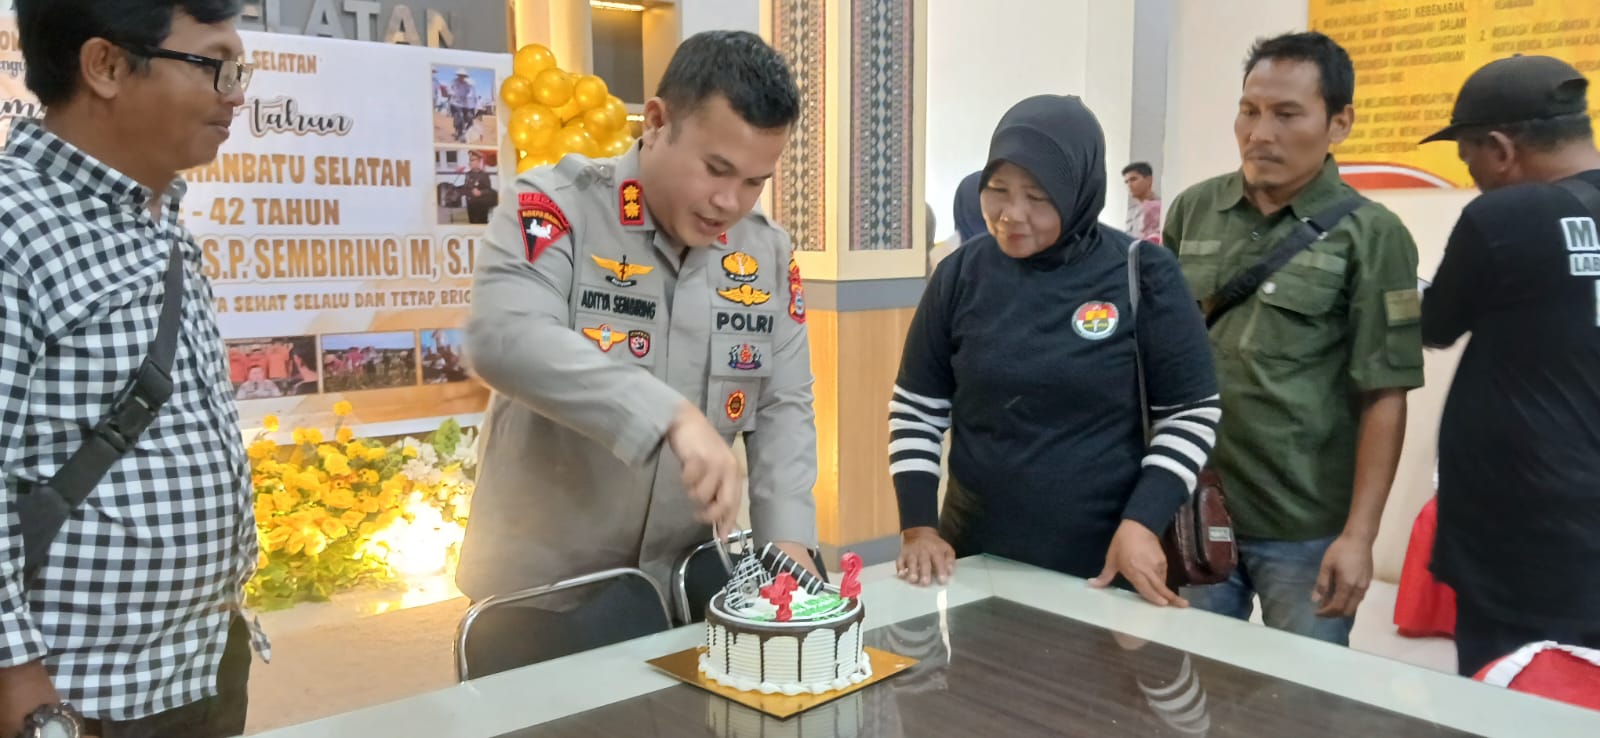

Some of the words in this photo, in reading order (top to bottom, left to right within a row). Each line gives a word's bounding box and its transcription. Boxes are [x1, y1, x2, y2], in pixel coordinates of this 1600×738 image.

[1439, 17, 1467, 31] DALAM
[252, 50, 317, 74] SELATAN
[252, 98, 352, 133] tahun
[314, 155, 411, 188] SELATAN
[209, 197, 245, 225] 42
[252, 198, 340, 226] TAHUN
[202, 238, 248, 280] S.P.
[254, 238, 399, 280] SEMBIRING
[409, 239, 438, 277] M,
[233, 294, 288, 313] SEHAT
[293, 293, 350, 310] SELALU
[355, 292, 386, 308] DAN
[391, 290, 436, 307] TETAP
[581, 289, 611, 311] ADITYA
[716, 311, 774, 334] POLRI
